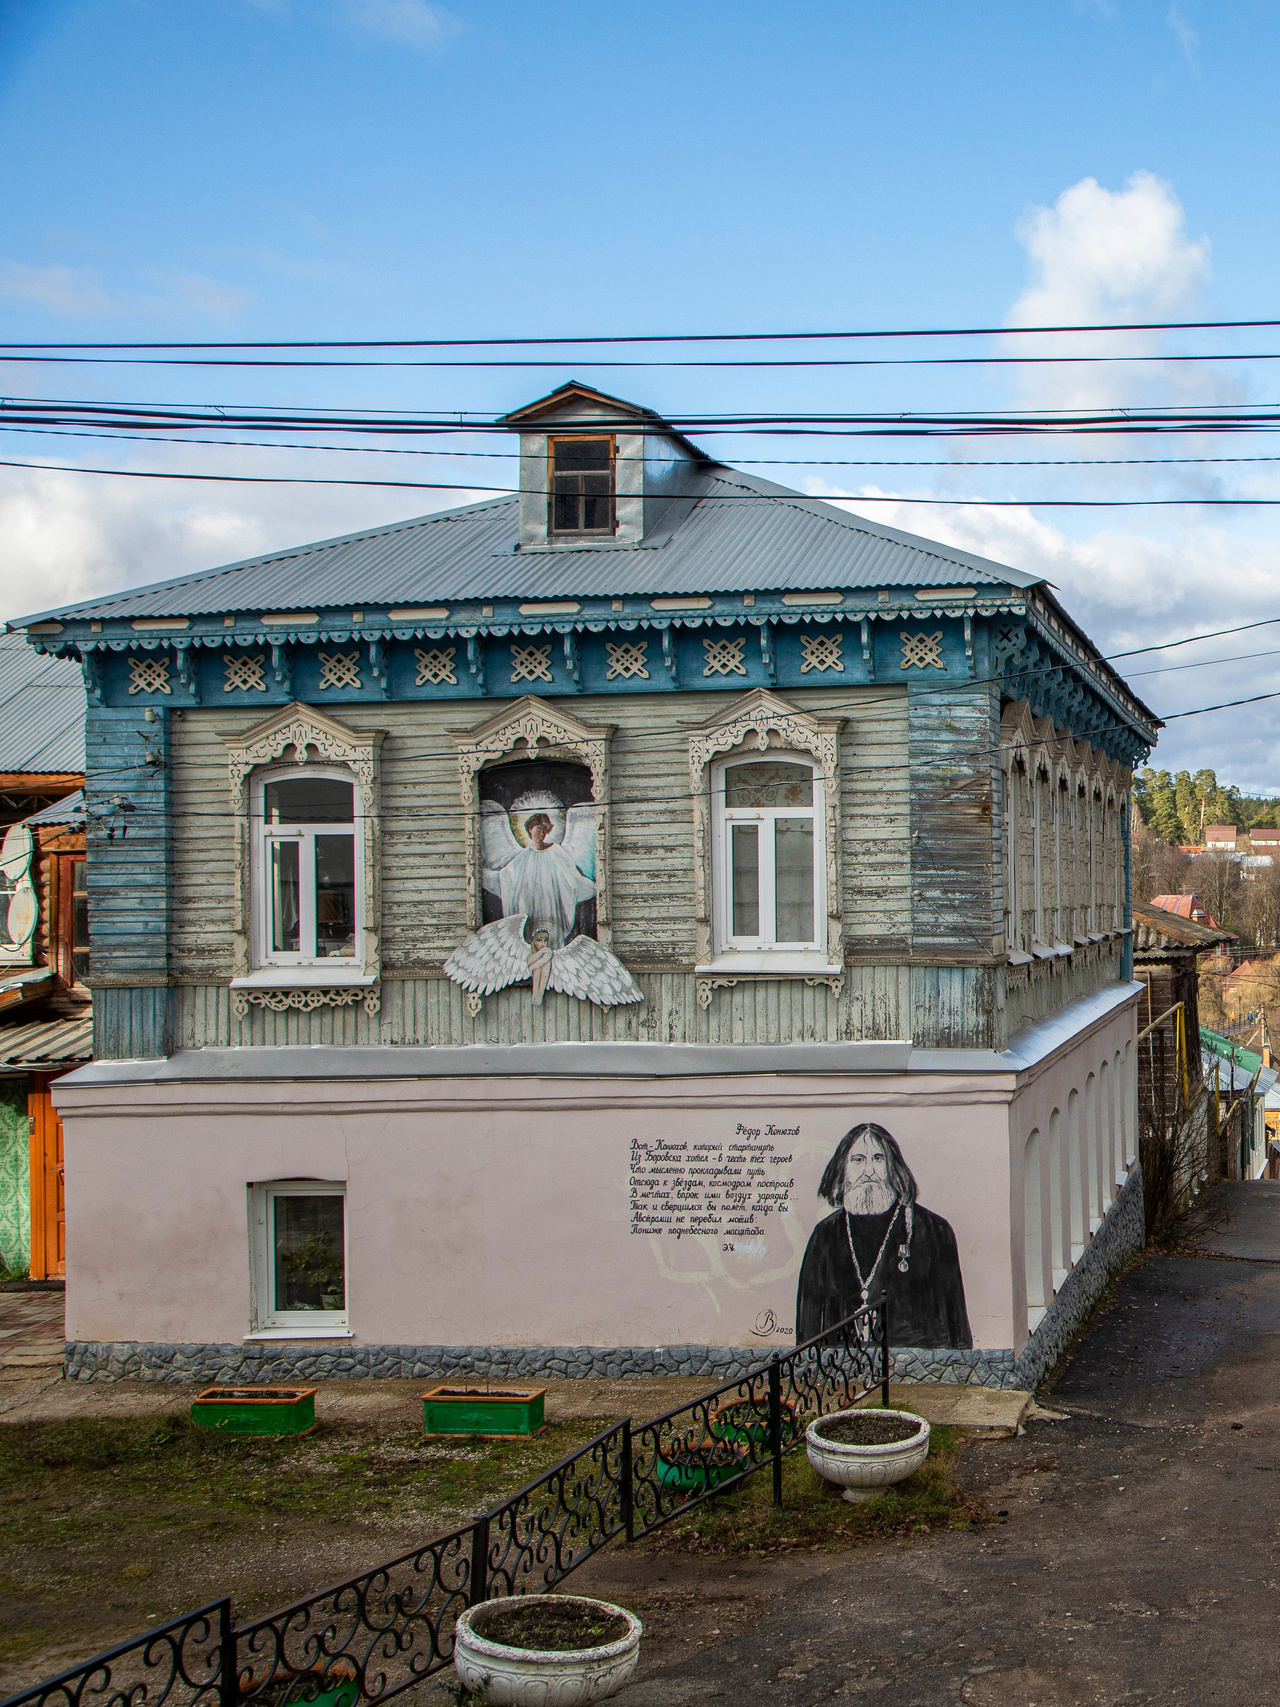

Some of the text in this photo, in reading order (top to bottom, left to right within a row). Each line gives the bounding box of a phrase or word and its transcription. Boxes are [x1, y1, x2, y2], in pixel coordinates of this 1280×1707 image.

[765, 1125, 800, 1135] Конюхов
[693, 1143, 722, 1152] который
[729, 1144, 774, 1155] стартануть
[631, 1151, 641, 1165] Из
[645, 1150, 681, 1164] Боровска
[686, 1154, 708, 1162] хотел
[770, 1155, 793, 1165] героев
[630, 1164, 646, 1173] Что
[688, 1166, 741, 1178] прокладывали
[747, 1167, 765, 1179] путь
[630, 1177, 659, 1190] Отсюда
[709, 1181, 751, 1190] космодром
[757, 1179, 794, 1190] построив
[629, 1187, 638, 1198] В
[640, 1190, 673, 1199] мечтах,
[677, 1190, 699, 1201] впрок
[726, 1189, 752, 1203] воздух
[630, 1200, 648, 1210] Так
[661, 1201, 702, 1213] свершился
[707, 1201, 716, 1211] бы
[752, 1205, 773, 1216] когда
[778, 1203, 788, 1212] бы
[631, 1211, 671, 1225] Австралии
[690, 1214, 722, 1226] перебил
[631, 1224, 662, 1234] Пониже
[668, 1225, 718, 1239] поднебесного
